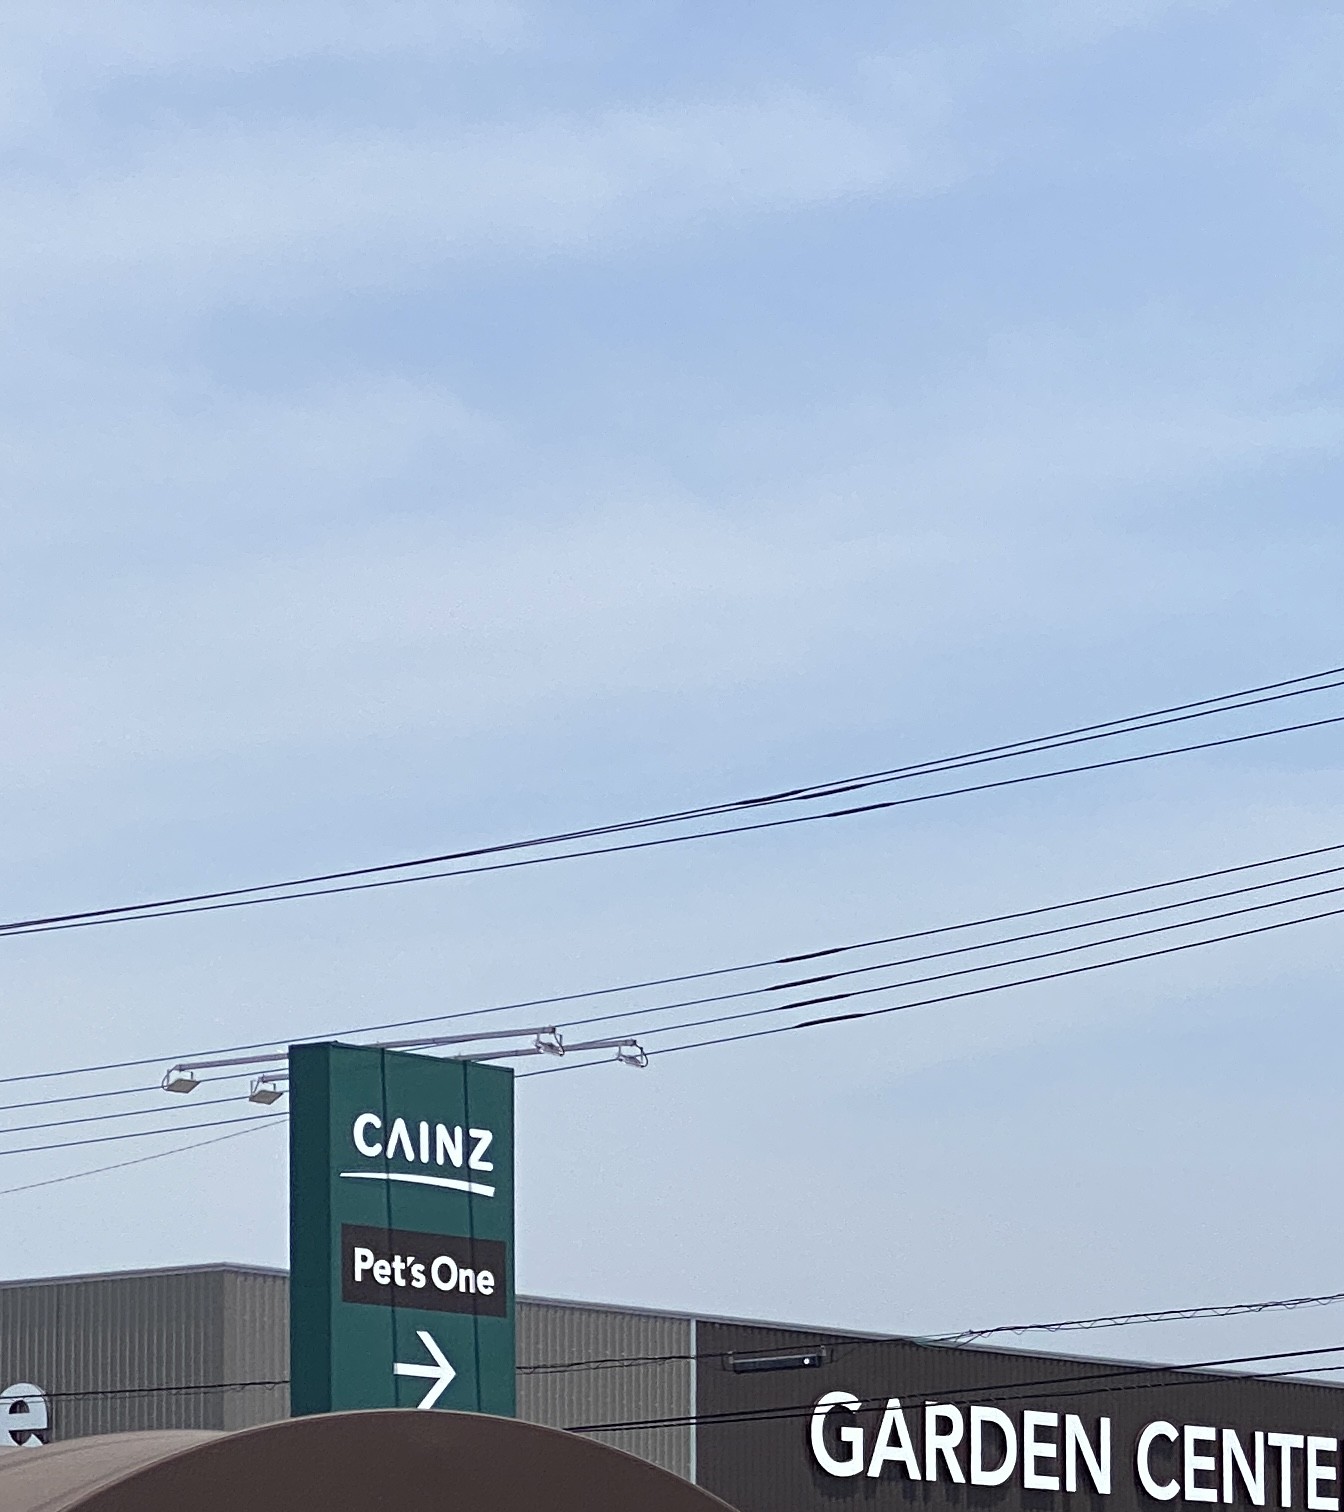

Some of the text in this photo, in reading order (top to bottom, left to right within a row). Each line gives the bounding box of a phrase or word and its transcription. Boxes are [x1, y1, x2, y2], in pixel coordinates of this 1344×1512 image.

[353, 1112, 494, 1172] CAINZ
[354, 1247, 495, 1295] Pet's One
[809, 1391, 1111, 1495] GARDEN
